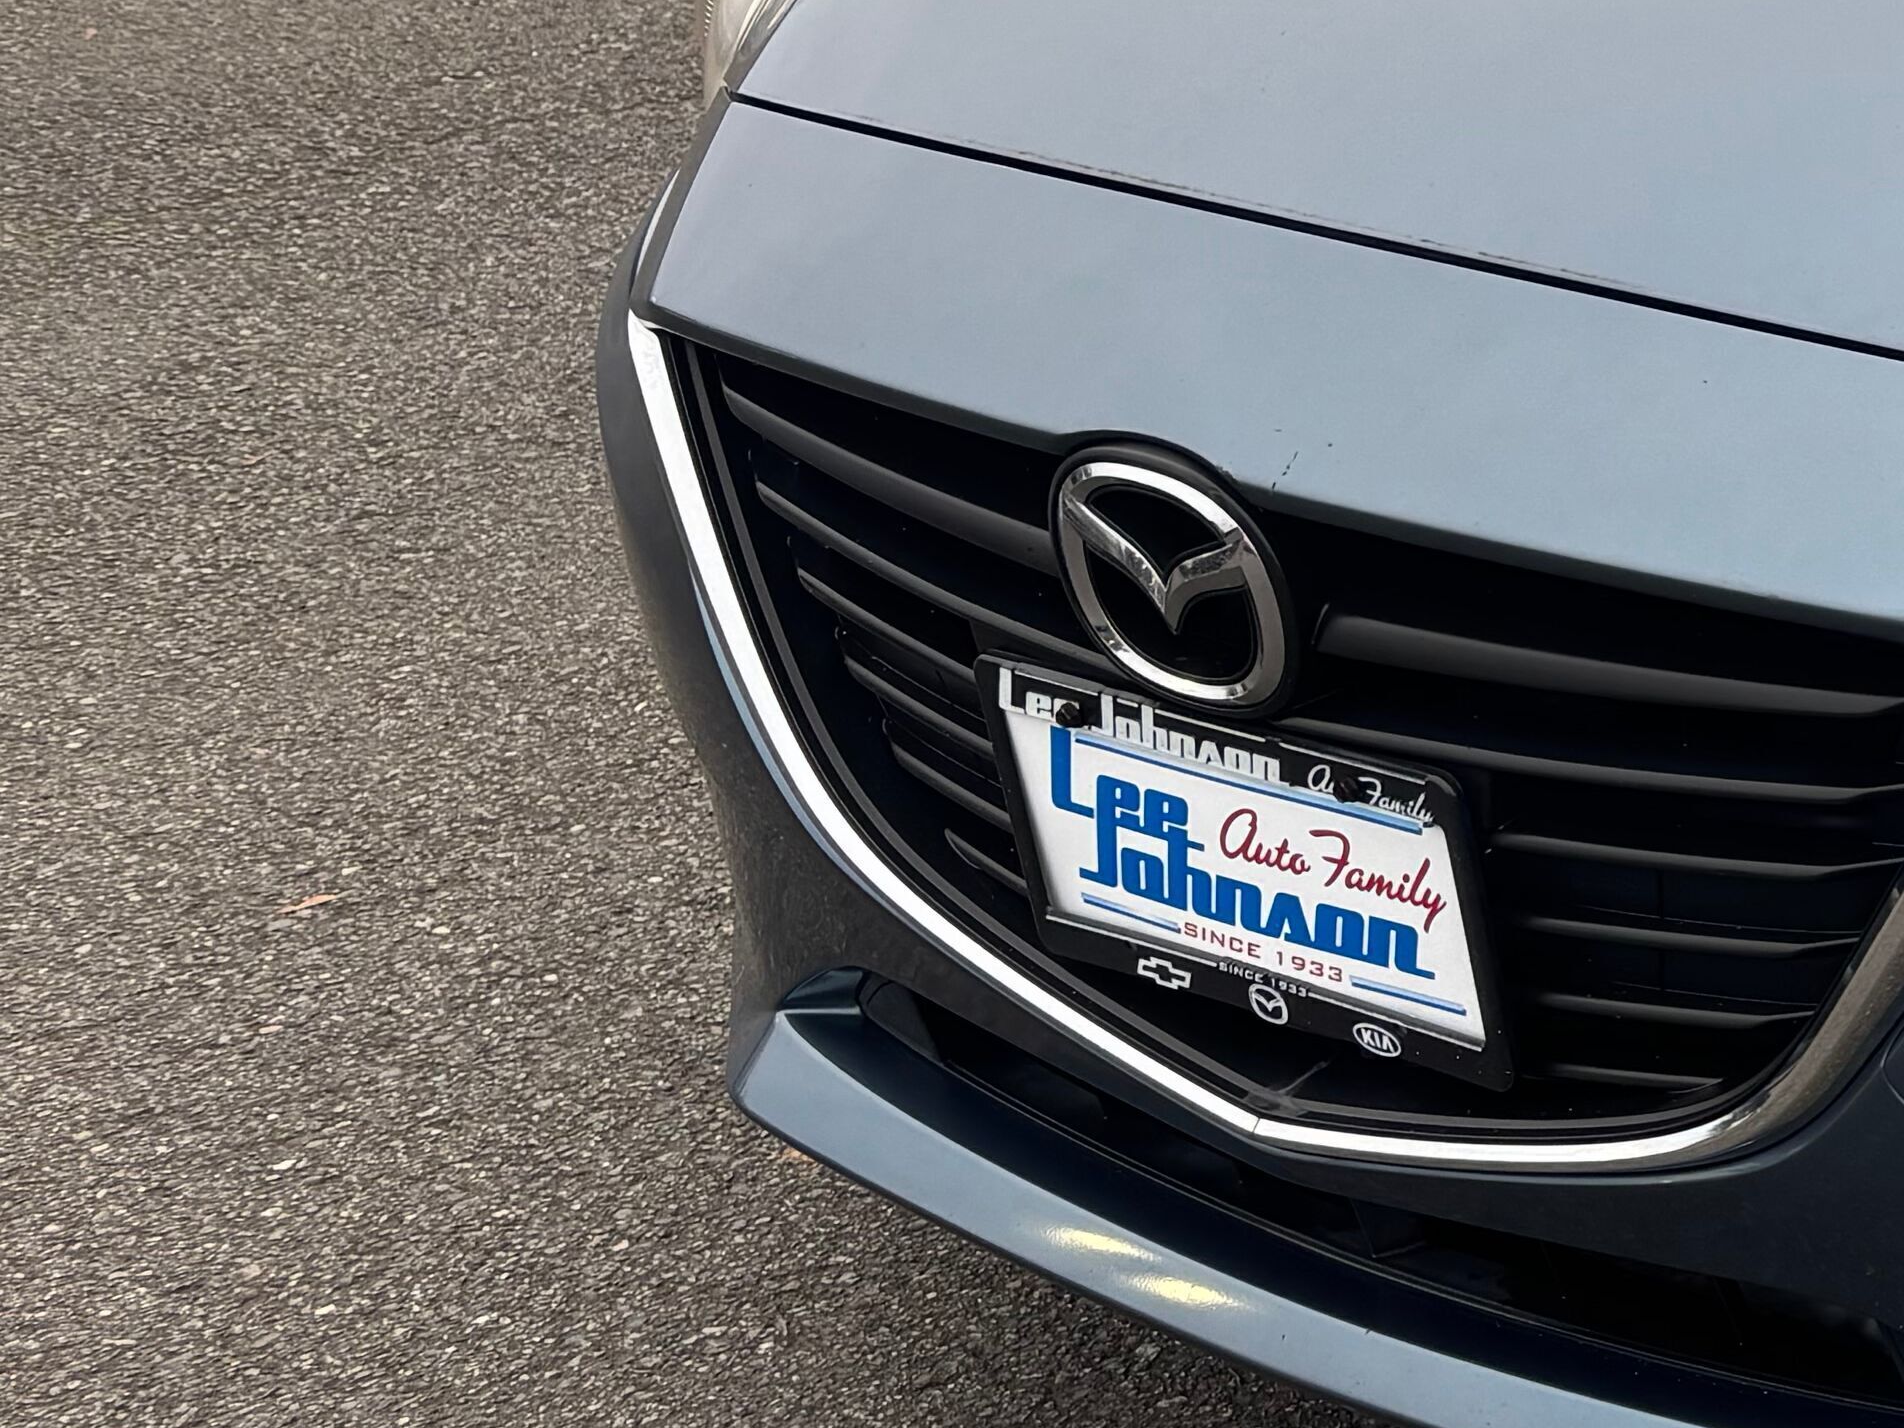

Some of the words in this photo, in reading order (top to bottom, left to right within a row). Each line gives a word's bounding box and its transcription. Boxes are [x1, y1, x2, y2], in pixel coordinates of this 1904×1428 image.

[1050, 725, 1205, 851] Lee
[1091, 692, 1290, 786] Johnson
[1080, 827, 1436, 981] Johnson
[1220, 808, 1311, 875] Auto
[1309, 829, 1447, 934] Family
[1184, 923, 1261, 958] SINCE
[1276, 951, 1344, 983] 1933
[1218, 962, 1264, 984] SINCE
[1271, 977, 1307, 998] 1933
